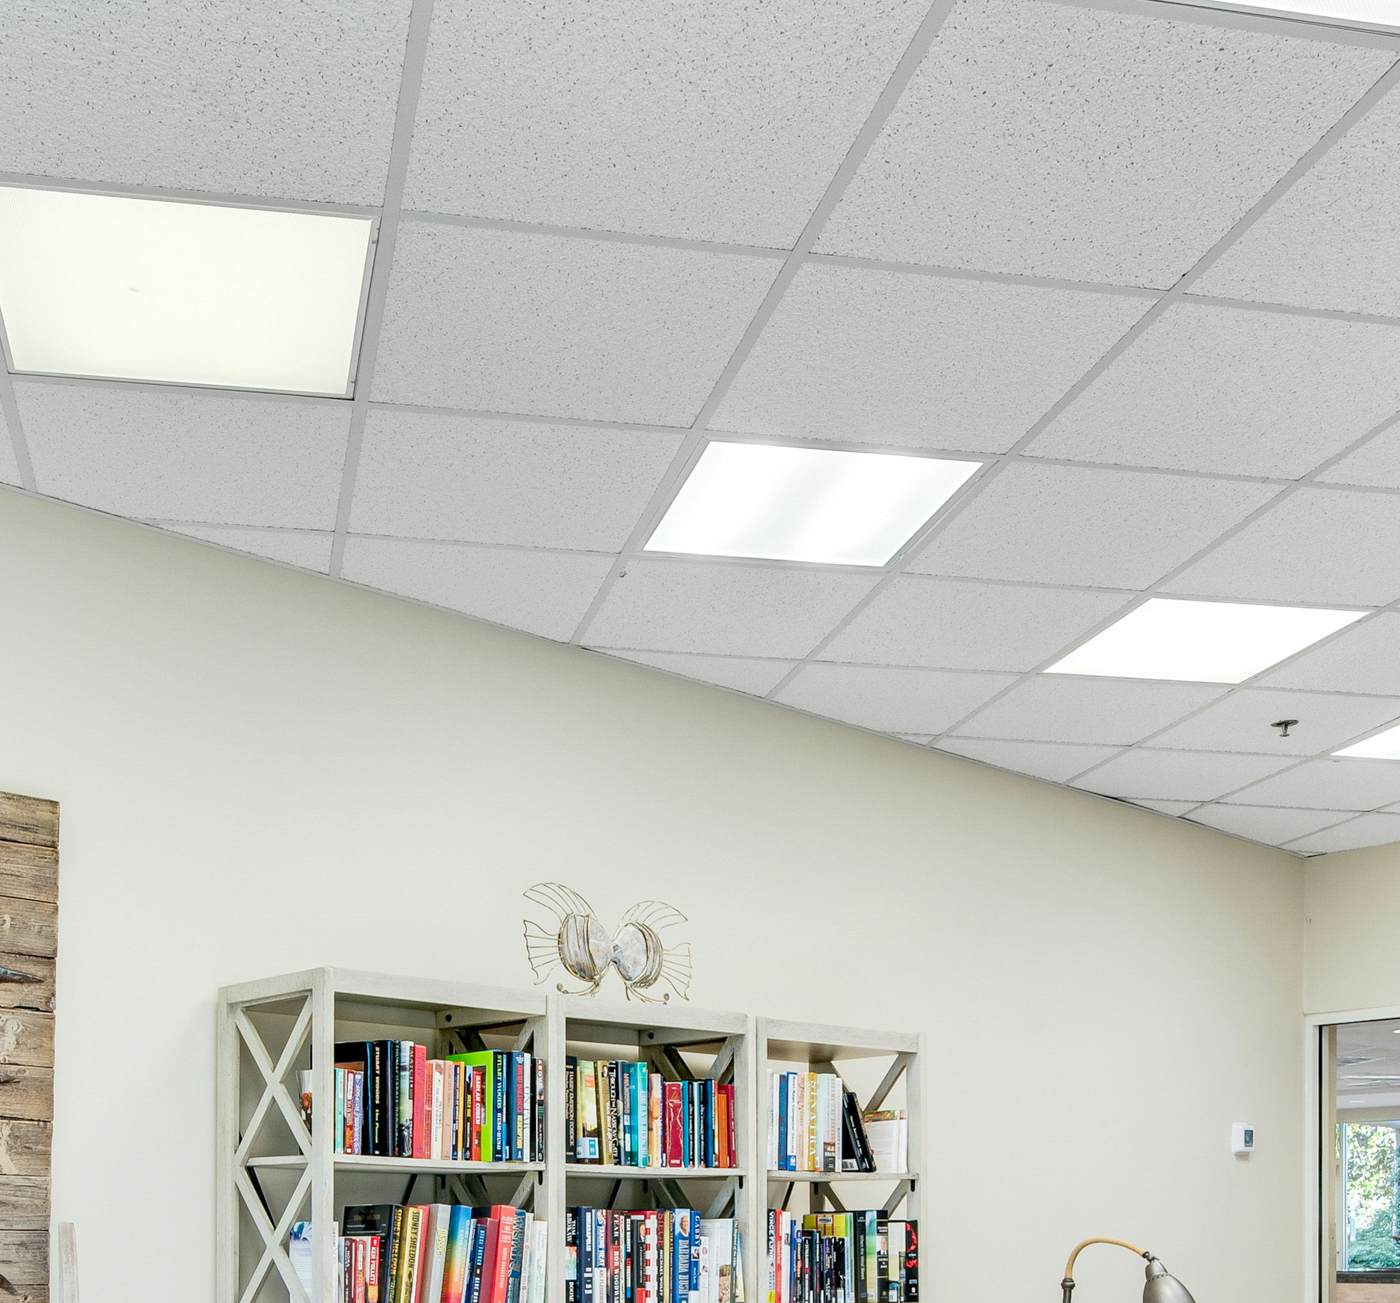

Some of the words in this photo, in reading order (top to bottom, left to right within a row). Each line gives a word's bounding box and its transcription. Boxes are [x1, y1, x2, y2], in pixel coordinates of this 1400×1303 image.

[393, 1208, 403, 1237] SIDNEY
[411, 1211, 420, 1236] SIDNEY
[613, 1213, 621, 1238] FEAR
[390, 1238, 400, 1276] SHELDON
[408, 1236, 417, 1269] SHELDON
